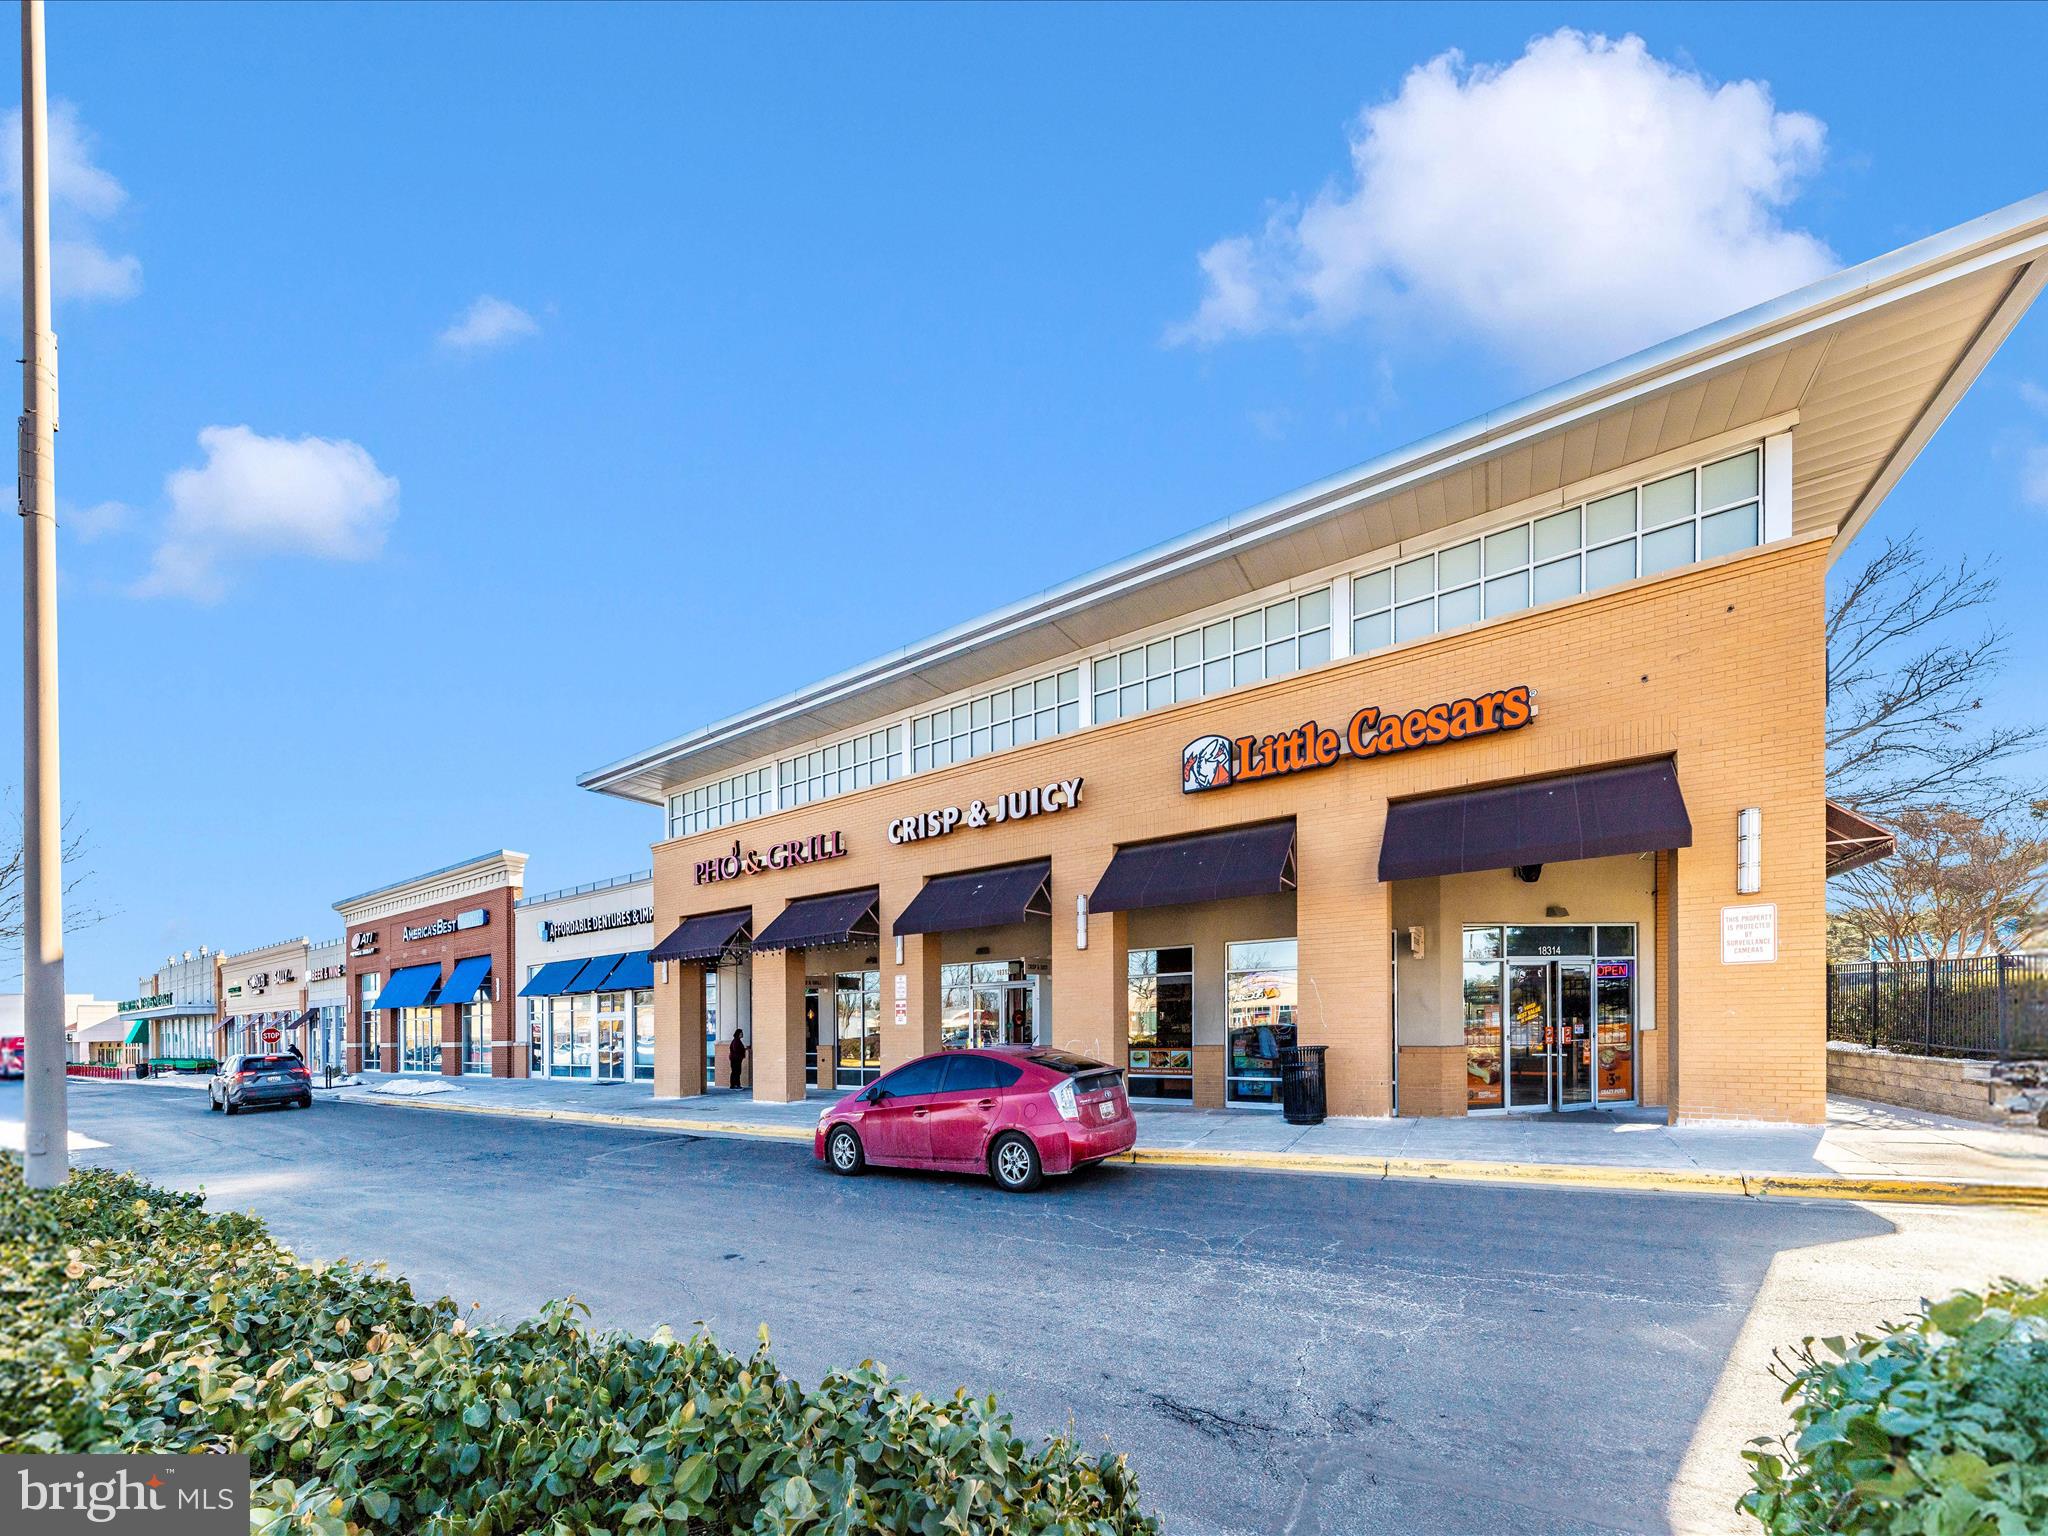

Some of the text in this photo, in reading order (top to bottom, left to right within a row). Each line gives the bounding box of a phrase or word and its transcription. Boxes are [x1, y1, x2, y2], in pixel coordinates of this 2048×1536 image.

[1235, 685, 1532, 782] Little Caesars
[888, 777, 1083, 845] CRISP & JUICY
[745, 849, 762, 875] &
[766, 831, 847, 870] GRILL
[1741, 914, 1772, 922] PROPERTY
[549, 919, 592, 940] AFFORDABLE
[593, 911, 631, 931] DENTURES
[633, 909, 640, 923] &
[1735, 922, 1771, 930] PROTECTED
[360, 932, 374, 945] ATI
[1726, 938, 1771, 946] SURVEILLANCE
[1538, 945, 1561, 955] 18314
[1733, 946, 1764, 954] CAMERAS
[311, 967, 324, 981] BEER
[1597, 965, 1627, 976] OPEN
